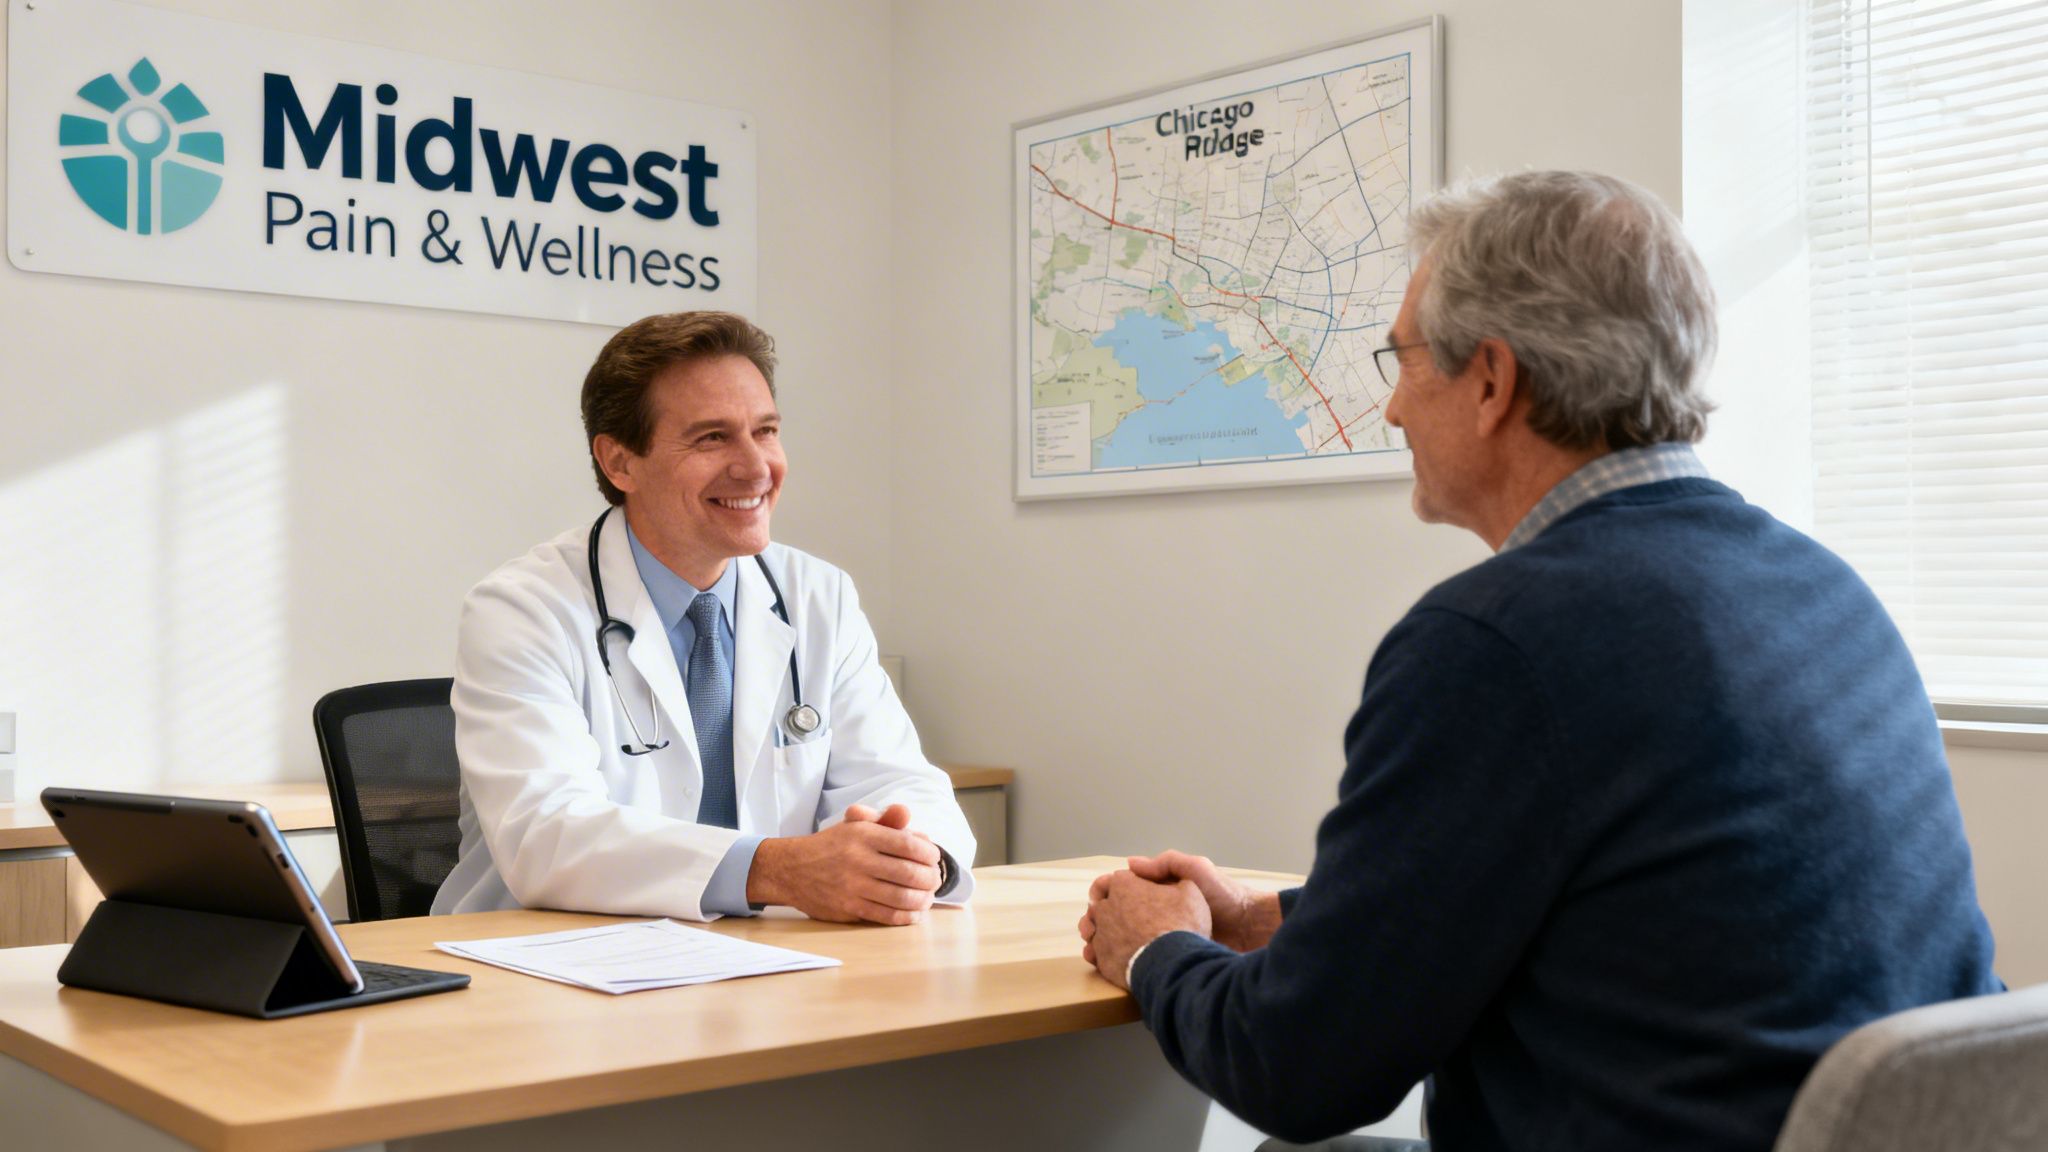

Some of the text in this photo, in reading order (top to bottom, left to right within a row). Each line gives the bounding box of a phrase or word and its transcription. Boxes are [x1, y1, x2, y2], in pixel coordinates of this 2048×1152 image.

[262, 72, 720, 228] Midwest
[266, 190, 721, 292] Pain & Wellness
